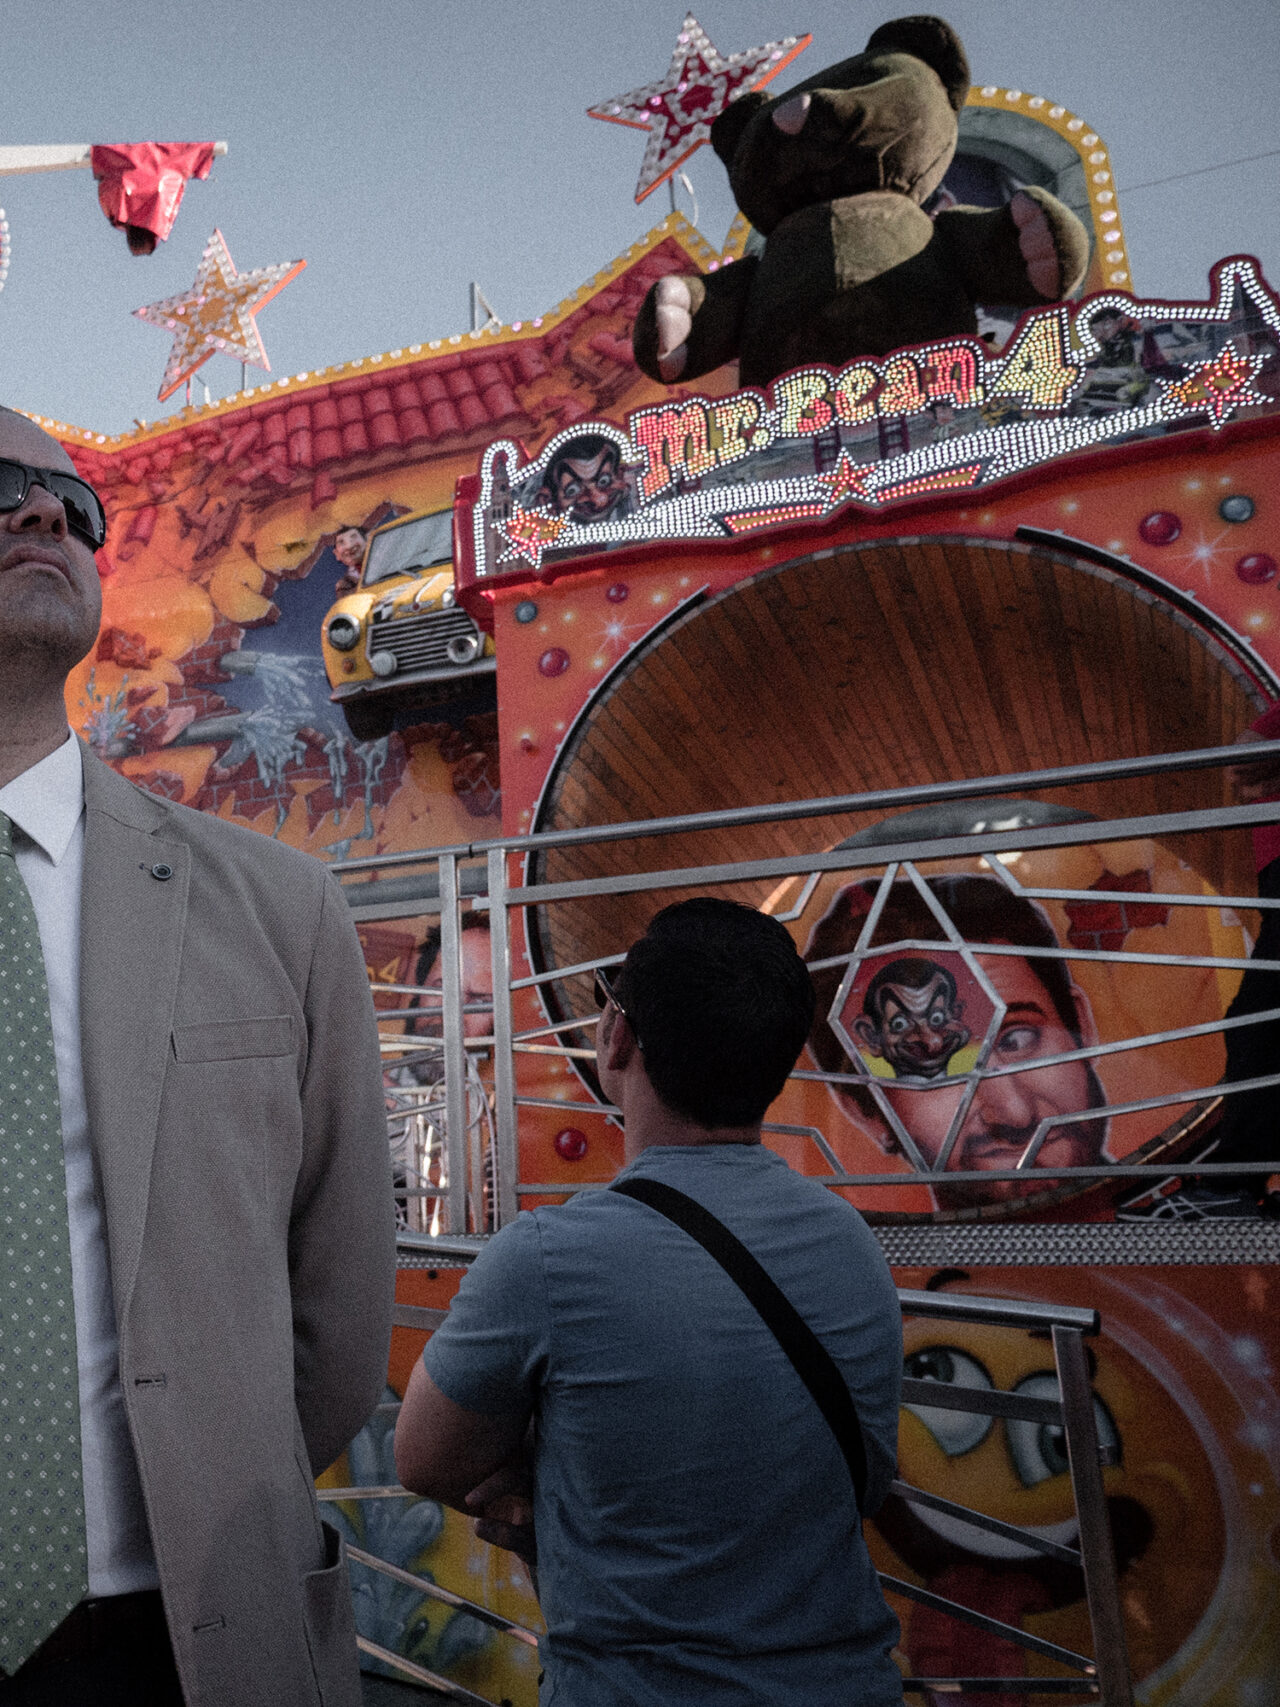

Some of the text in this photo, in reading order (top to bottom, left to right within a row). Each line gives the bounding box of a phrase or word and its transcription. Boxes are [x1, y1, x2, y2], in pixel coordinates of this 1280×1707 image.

[633, 309, 1081, 503] Mr. Bean 4
